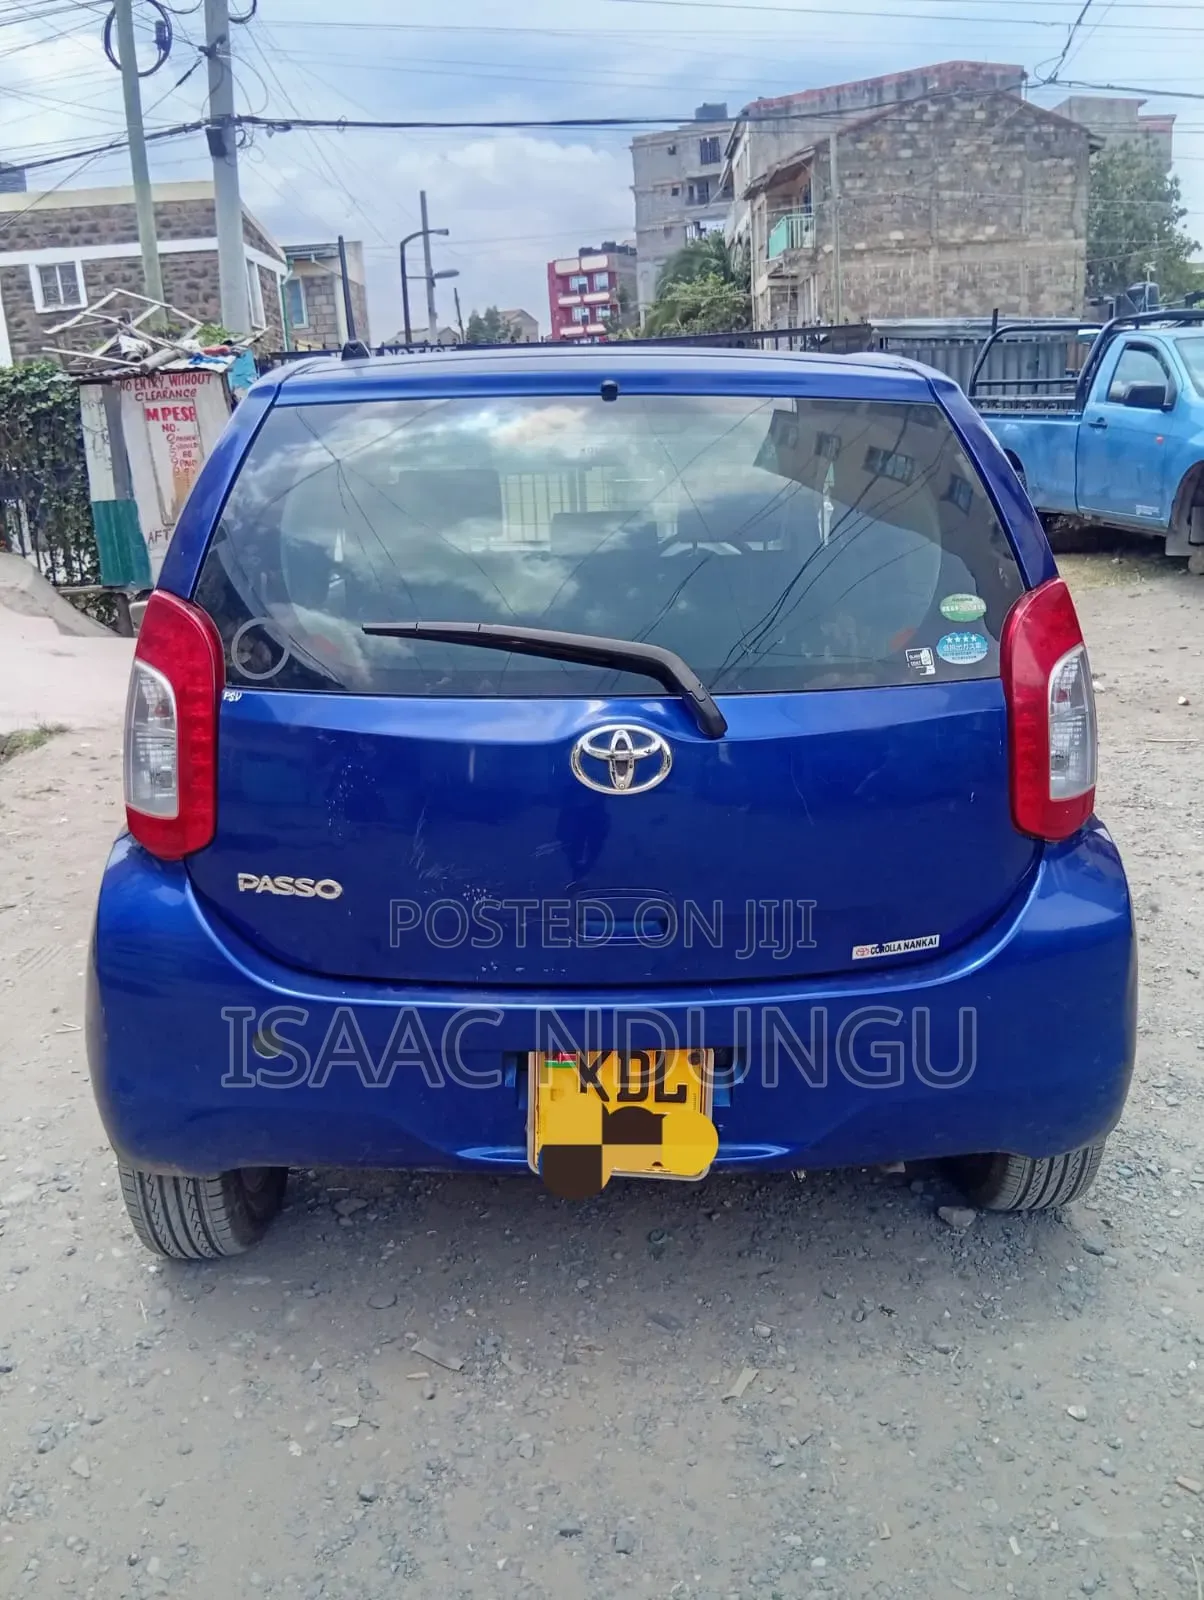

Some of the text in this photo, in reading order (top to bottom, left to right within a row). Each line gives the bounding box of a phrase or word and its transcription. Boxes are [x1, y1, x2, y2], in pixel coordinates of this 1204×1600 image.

[169, 372, 212, 387] WITHOUT
[238, 873, 342, 899] PASSO
[903, 937, 937, 950] NANKAI
[578, 1050, 687, 1103] KDL
